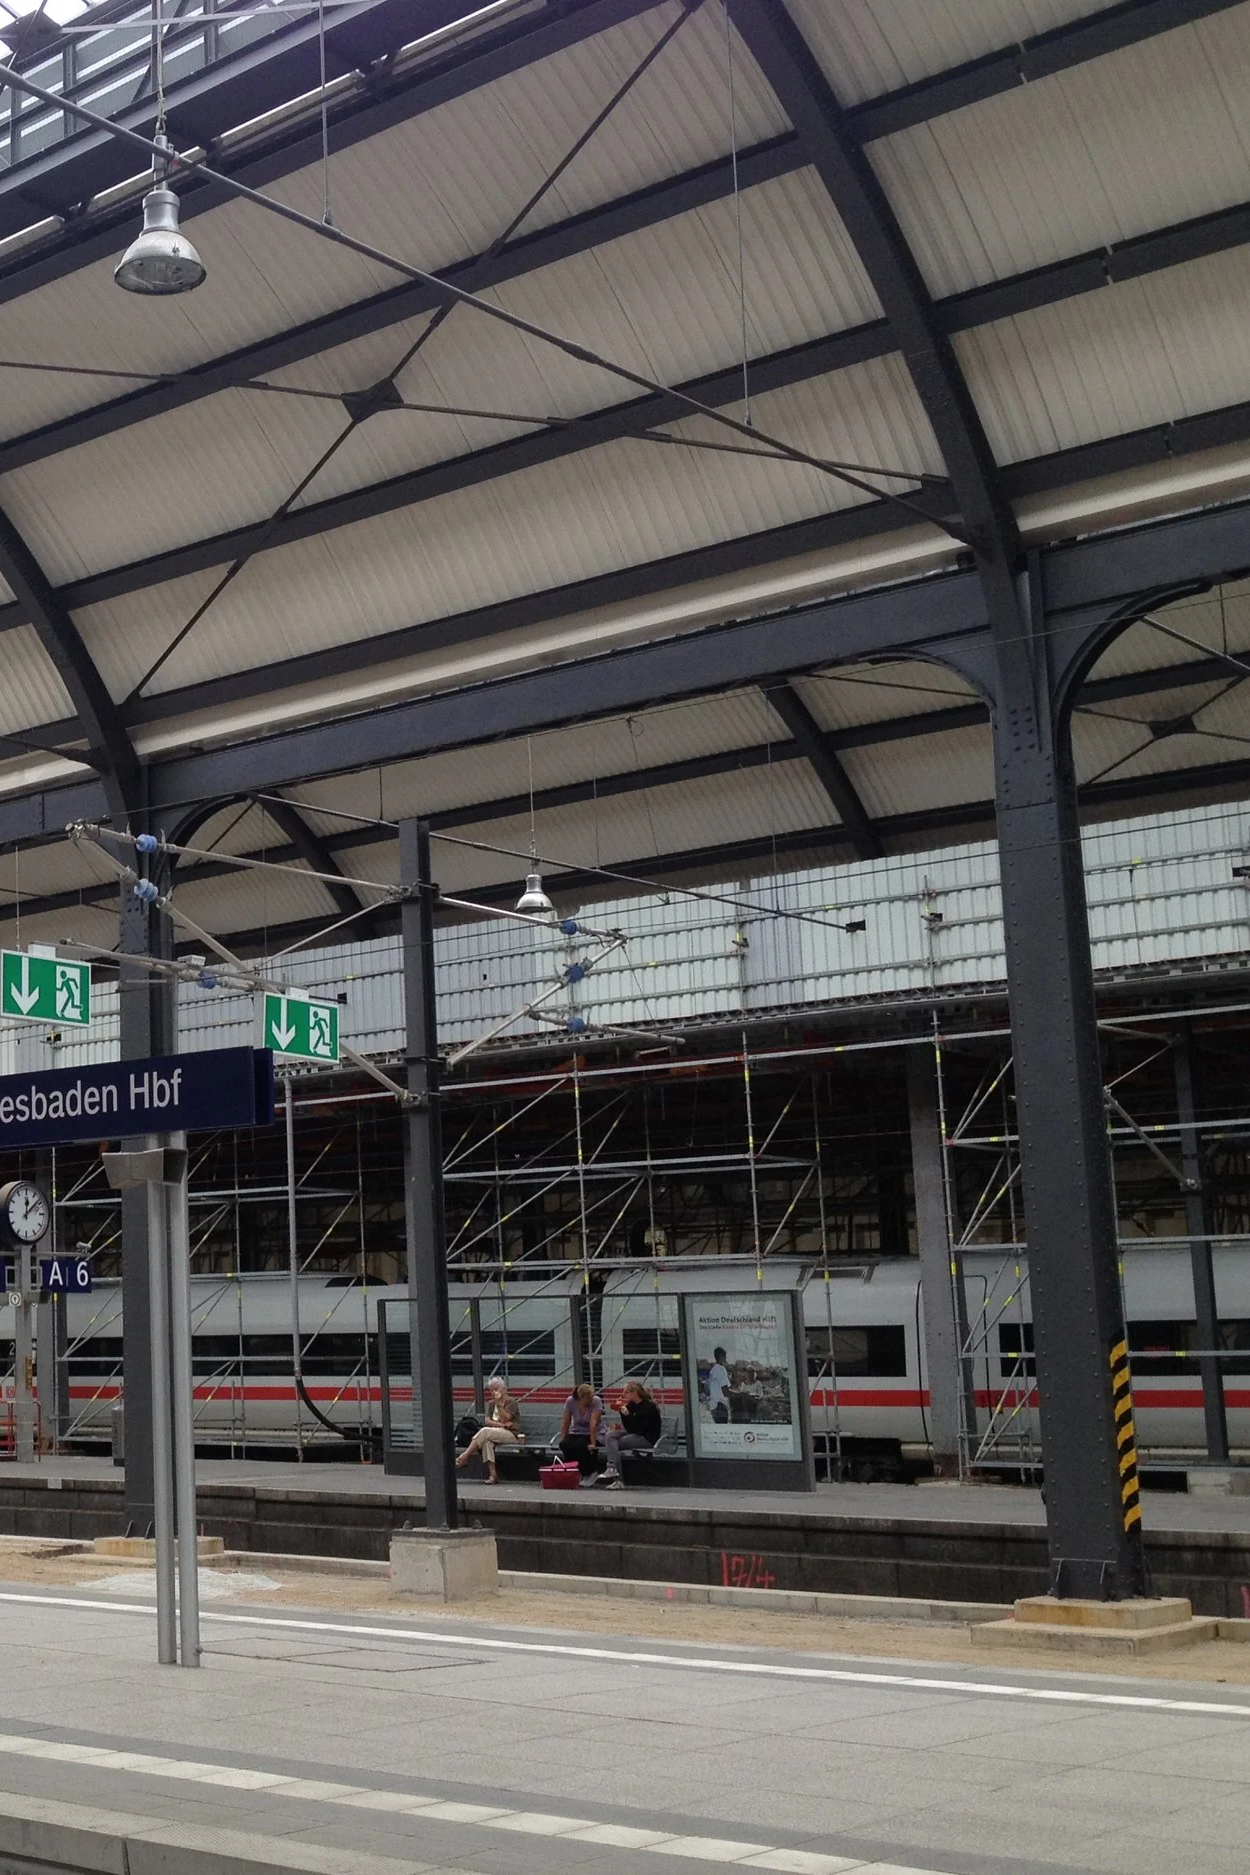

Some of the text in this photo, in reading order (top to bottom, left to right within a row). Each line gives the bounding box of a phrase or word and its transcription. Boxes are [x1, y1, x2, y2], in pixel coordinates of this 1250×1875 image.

[129, 1068, 182, 1110] Hbf
[49, 1261, 89, 1286] A 6
